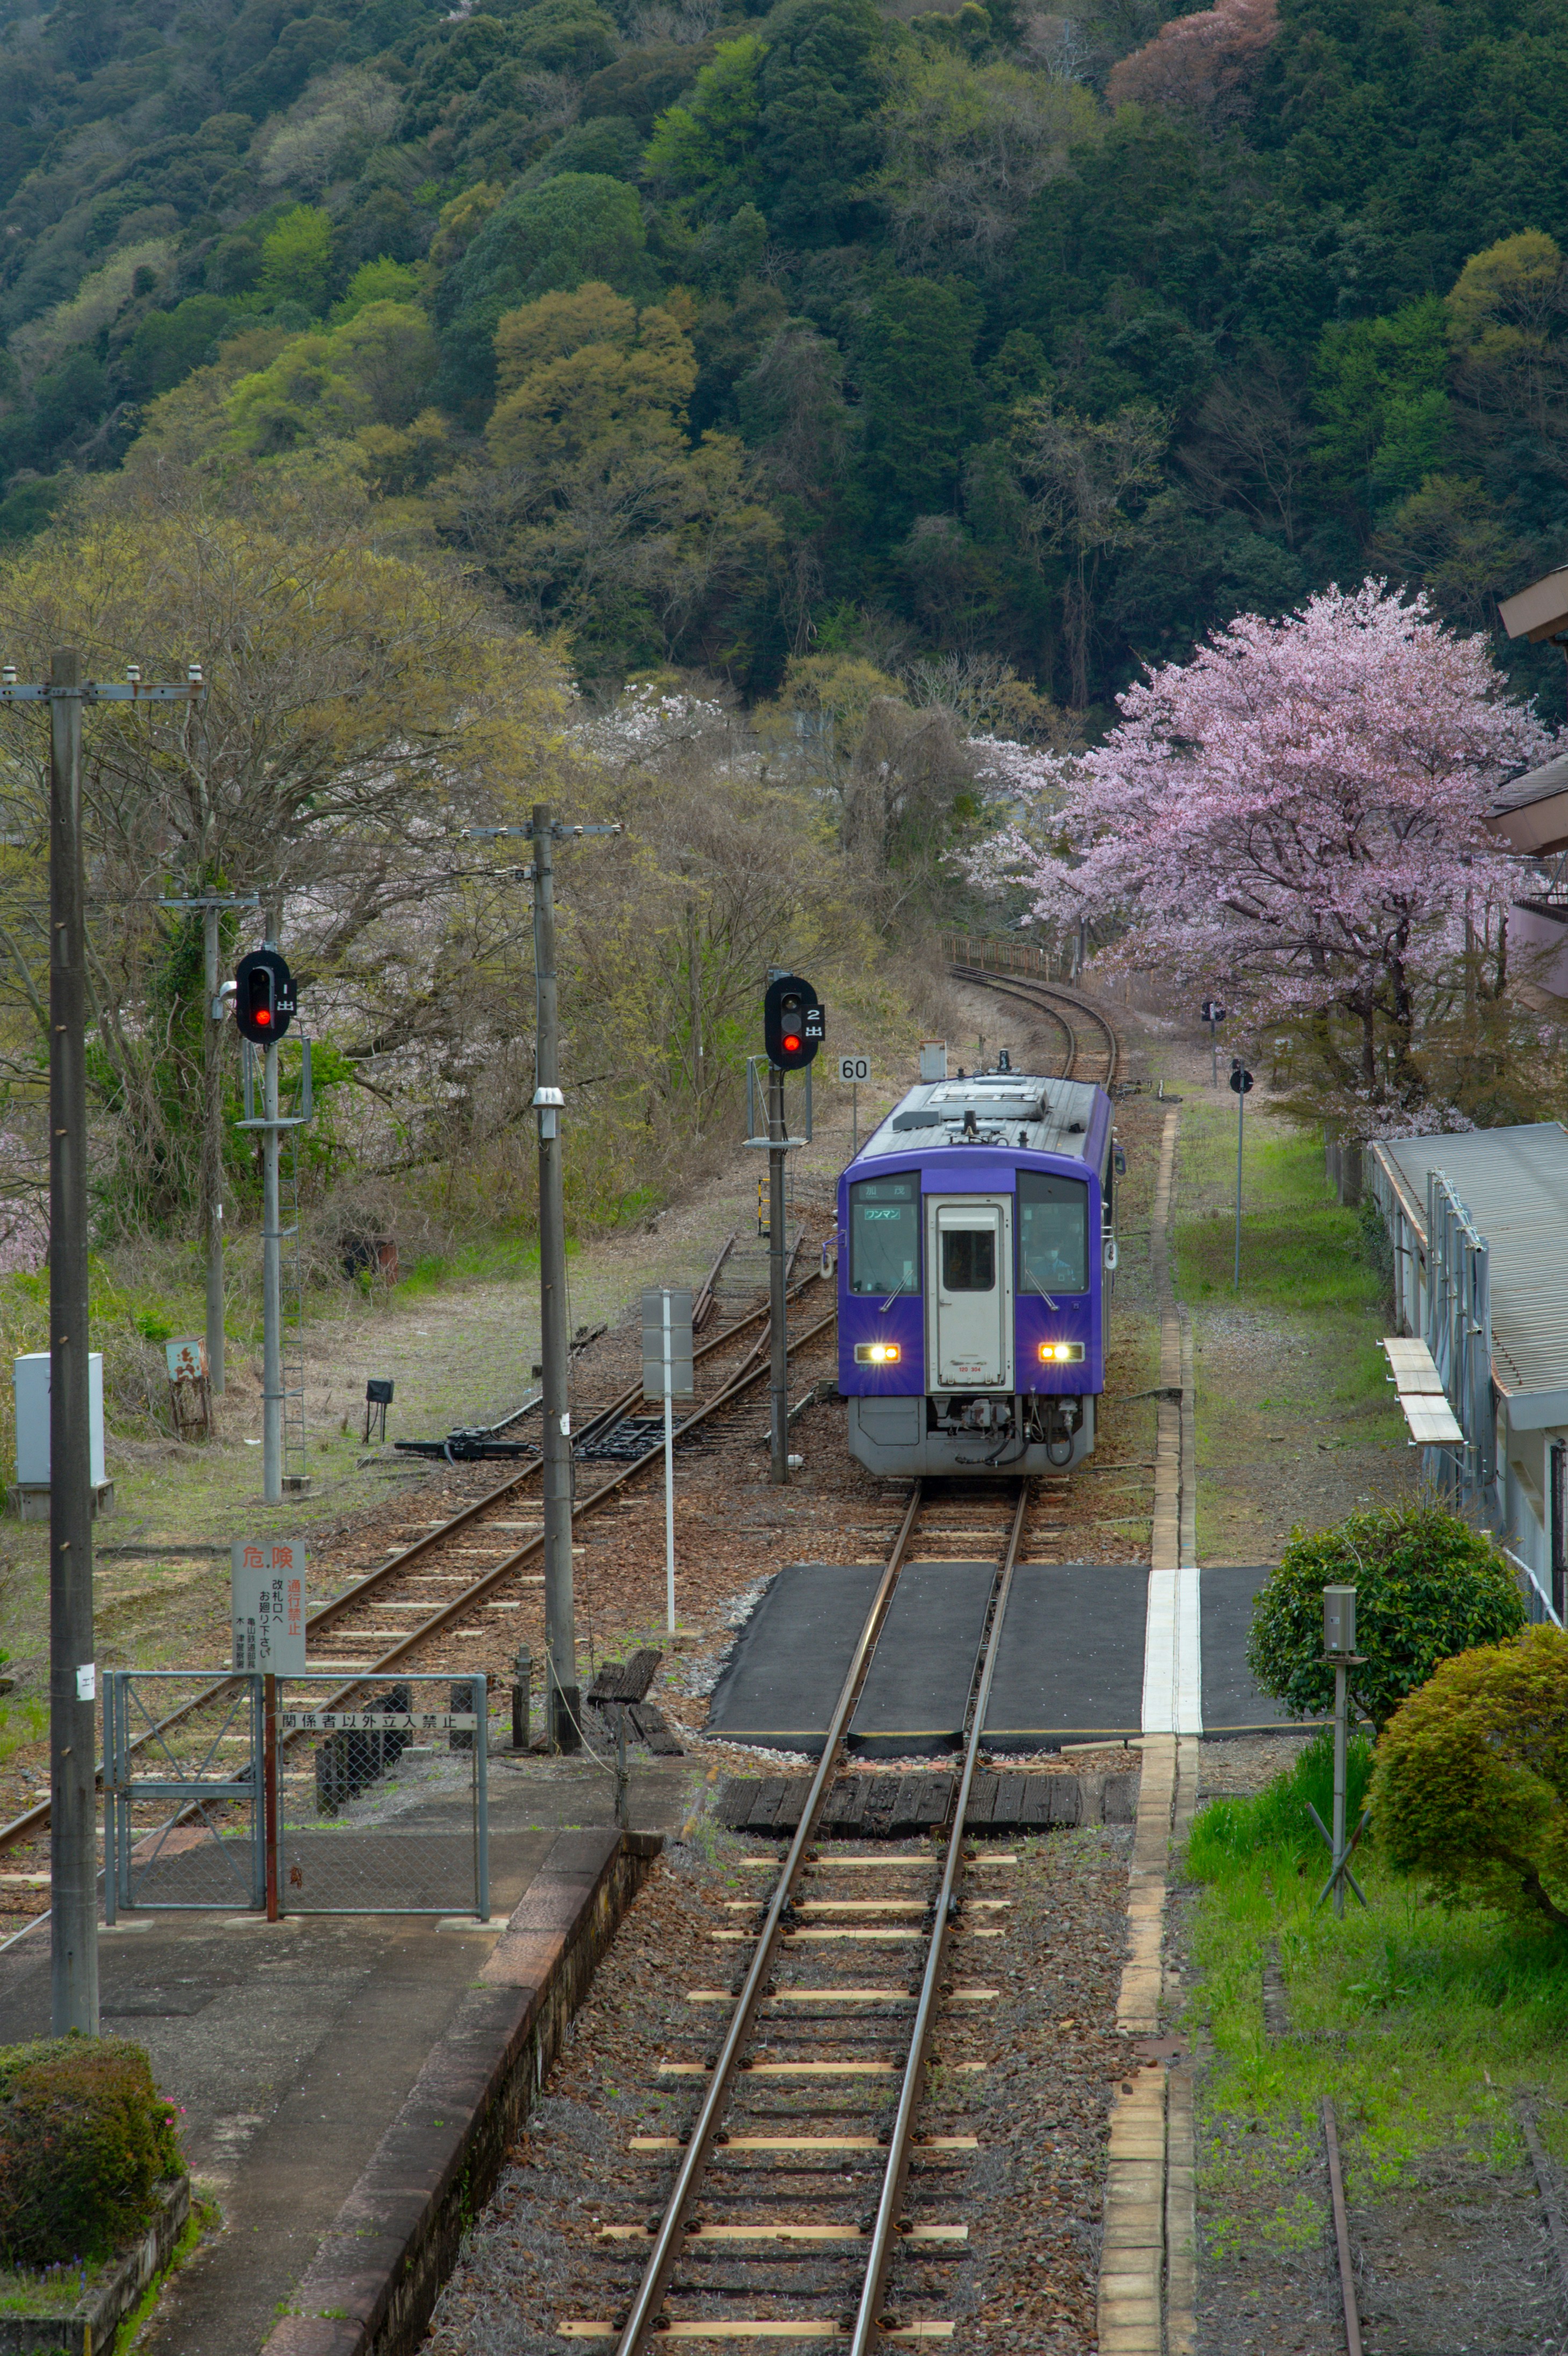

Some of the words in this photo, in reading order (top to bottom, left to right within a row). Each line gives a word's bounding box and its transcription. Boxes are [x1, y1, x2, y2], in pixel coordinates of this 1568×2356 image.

[843, 1060, 867, 1078] 60
[866, 1210, 899, 1219] ワンマン
[243, 1546, 293, 1569] 危険
[272, 1579, 283, 1623] 改札口へ
[288, 1579, 301, 1635] 通行禁止
[259, 1591, 270, 1658] お廻り下さい
[247, 1617, 256, 1669] 亀山鉄道部長
[282, 1714, 456, 1728] 関係者以外立入禁止
